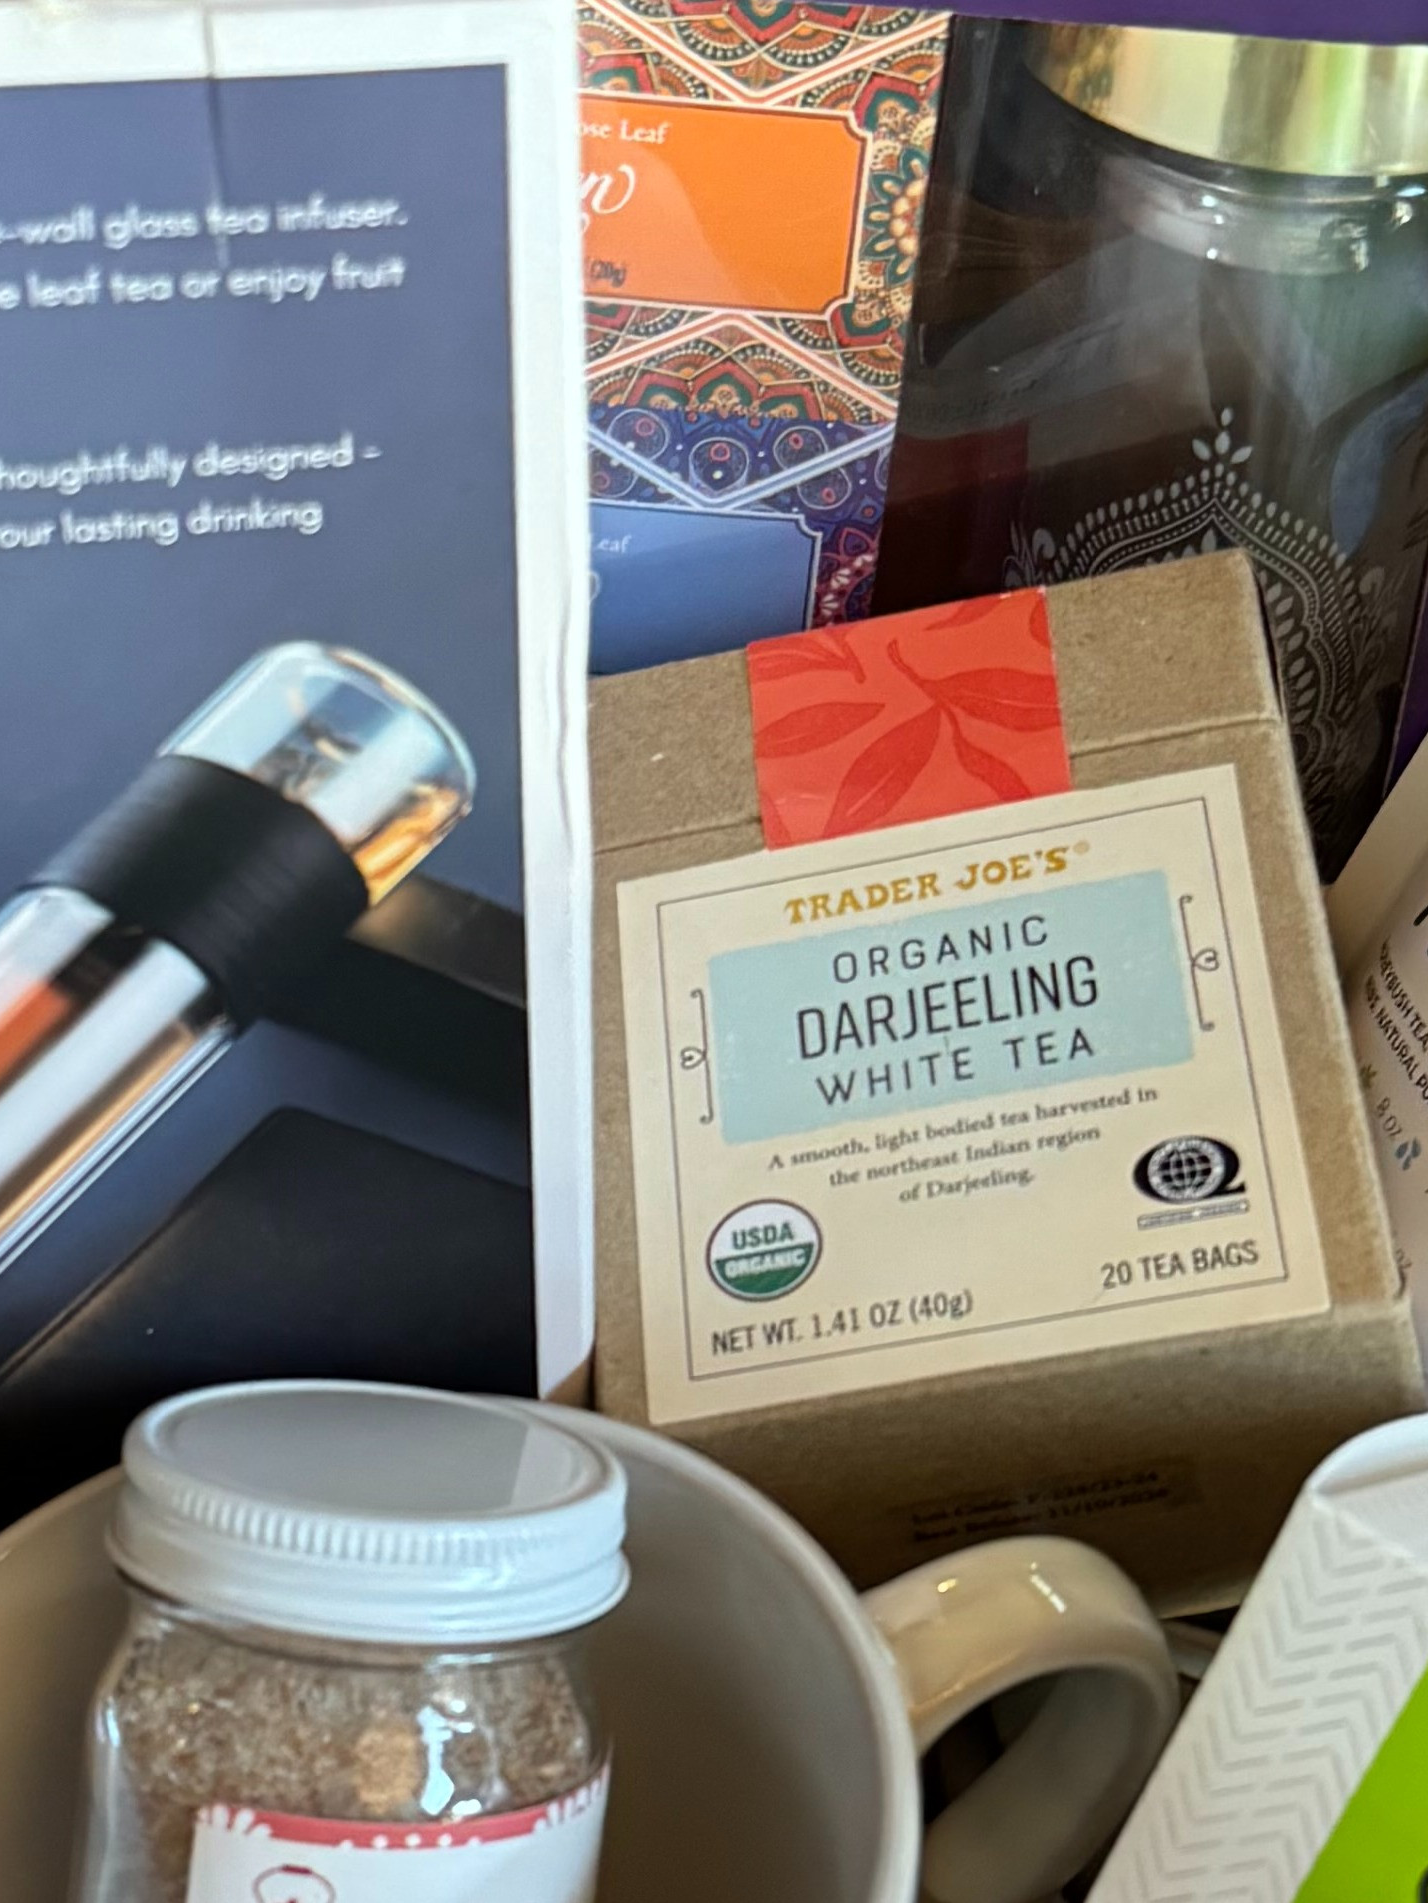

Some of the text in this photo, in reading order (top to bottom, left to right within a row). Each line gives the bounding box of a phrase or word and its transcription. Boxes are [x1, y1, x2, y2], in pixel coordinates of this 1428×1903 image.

[620, 119, 670, 144] Leaf
[103, 201, 200, 250] glass
[206, 203, 270, 235] tea
[276, 191, 409, 232] infuser.
[26, 262, 102, 309] leaf
[109, 271, 173, 305] tea
[179, 270, 221, 299] or
[227, 266, 327, 304] enjoy
[331, 251, 406, 291] fruit
[192, 430, 354, 480] designed
[59, 508, 180, 546] lasting
[185, 497, 323, 535] drinking
[783, 872, 942, 925] TRADER
[832, 915, 1048, 984] ORGANIC
[796, 956, 1099, 1060] DARJEELING
[816, 1028, 1095, 1106] WHITE TEA
[1375, 1008, 1419, 1080] NATURAL
[767, 1086, 1159, 1172] A smooth, light bodied tea harvested in
[829, 1126, 1101, 1188] the northeast Indian region
[898, 1168, 1036, 1203] of Darjeeling.
[724, 1248, 806, 1279] ORGANIC
[731, 1221, 796, 1250] USDA
[1101, 1238, 1259, 1290] 20 TEA BAGS
[711, 1288, 974, 1356] NET WT. 1.41 OZ (40g)
